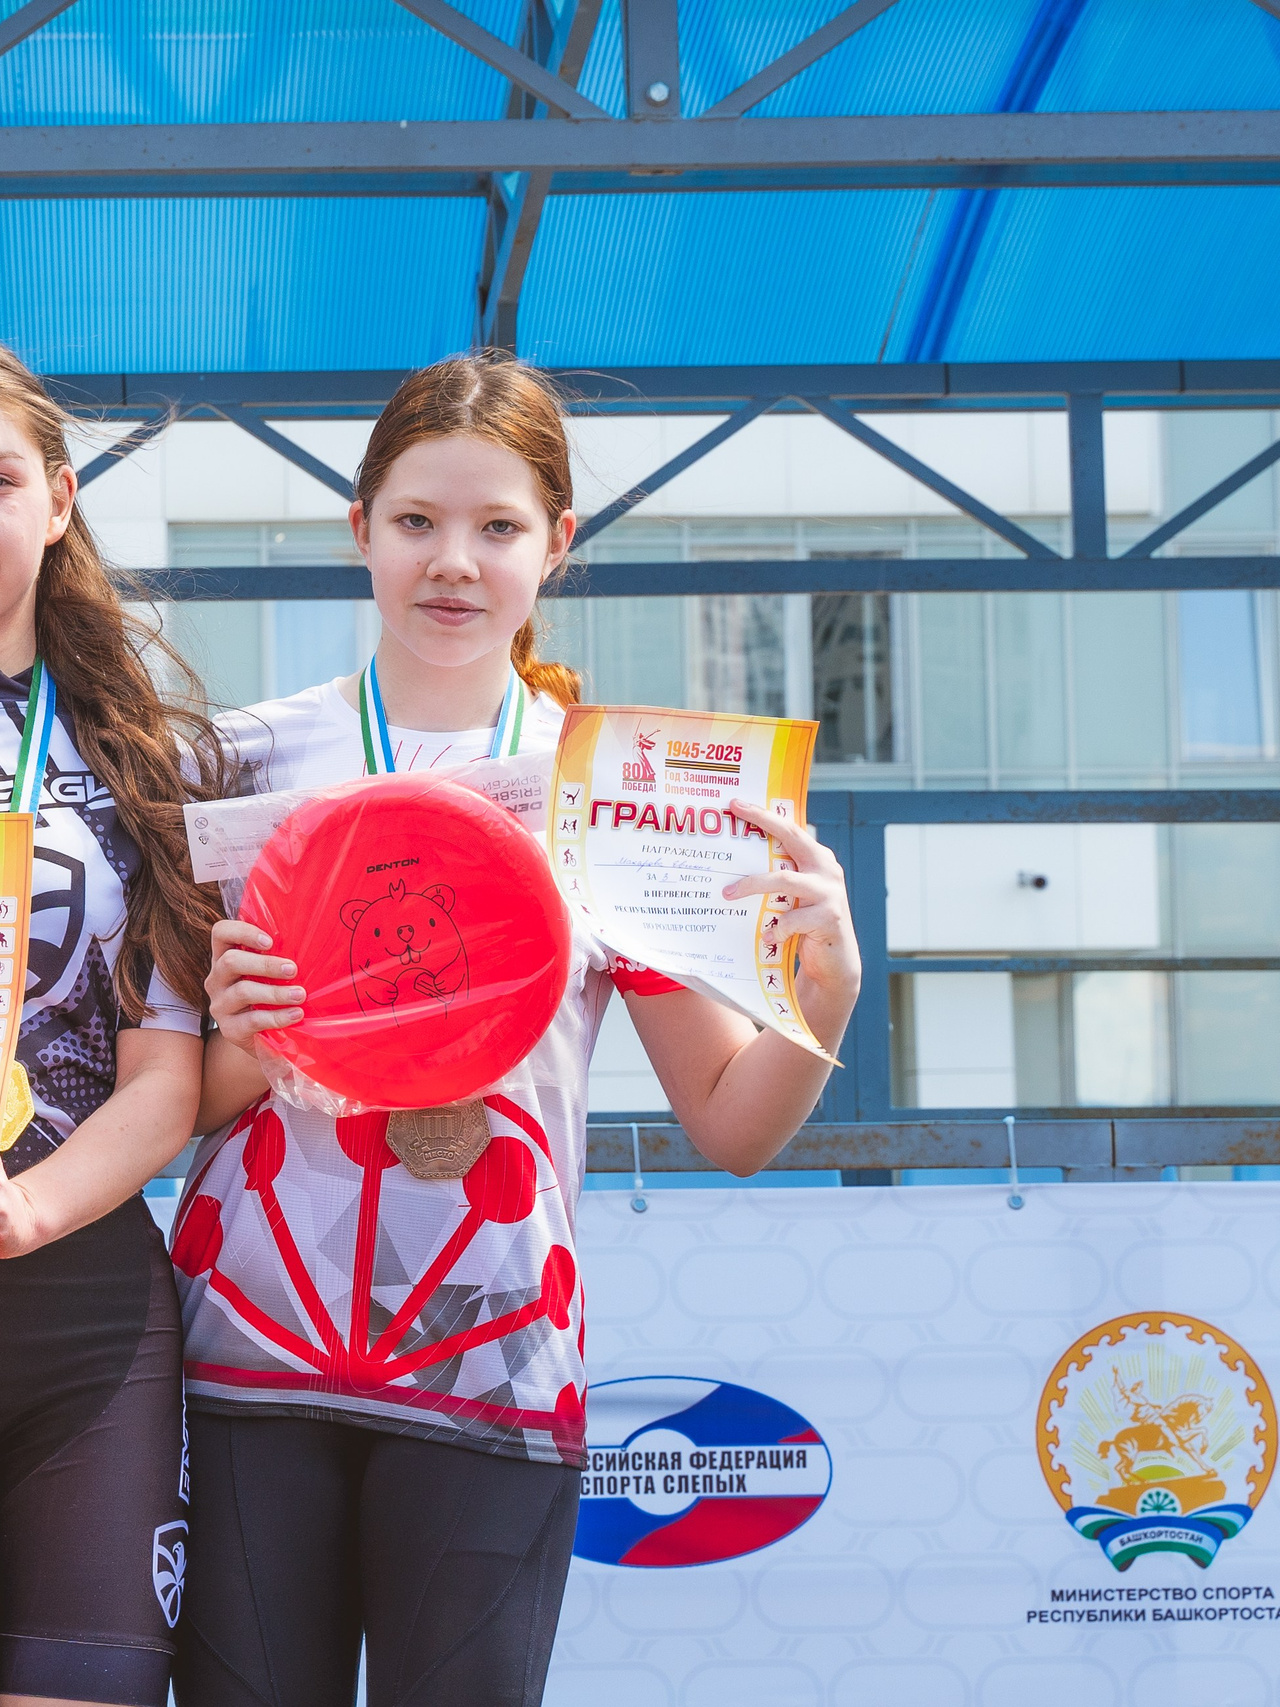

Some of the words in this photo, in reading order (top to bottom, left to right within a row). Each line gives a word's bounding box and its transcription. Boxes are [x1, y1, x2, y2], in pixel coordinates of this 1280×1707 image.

[667, 741, 742, 762] 1945-2025
[622, 762, 640, 779] 80
[665, 770, 680, 781] Год
[684, 772, 739, 786] Защитника
[482, 775, 540, 791] ФРИСБИ
[622, 782, 656, 792] ПОБЕДА!
[491, 787, 541, 801] FRISBE
[665, 784, 720, 798] Отечества
[588, 799, 768, 839] ГРАМОТА
[642, 845, 732, 861] НАГРАЖДАЕТСЯ
[366, 857, 420, 874] DENTON
[679, 875, 712, 883] МЕСТО
[615, 905, 668, 914] РЕСПУБЛИКИ
[671, 908, 748, 916] БАШКОРТОСТАН
[655, 924, 684, 932] РОЛЛЕР
[424, 1150, 454, 1159] МЕСТО
[587, 1448, 681, 1472] СИЙСКАЯ
[690, 1450, 807, 1471] ФЕДЕРАЦИЯ
[580, 1476, 655, 1495] СПОРТА
[664, 1474, 746, 1494] СЛЕПЫХ
[1051, 1587, 1197, 1602] МИНИСТЕРСТВО
[1203, 1587, 1274, 1601] СПОРТА
[1027, 1610, 1146, 1623] РЕСПУБЛИКИ
